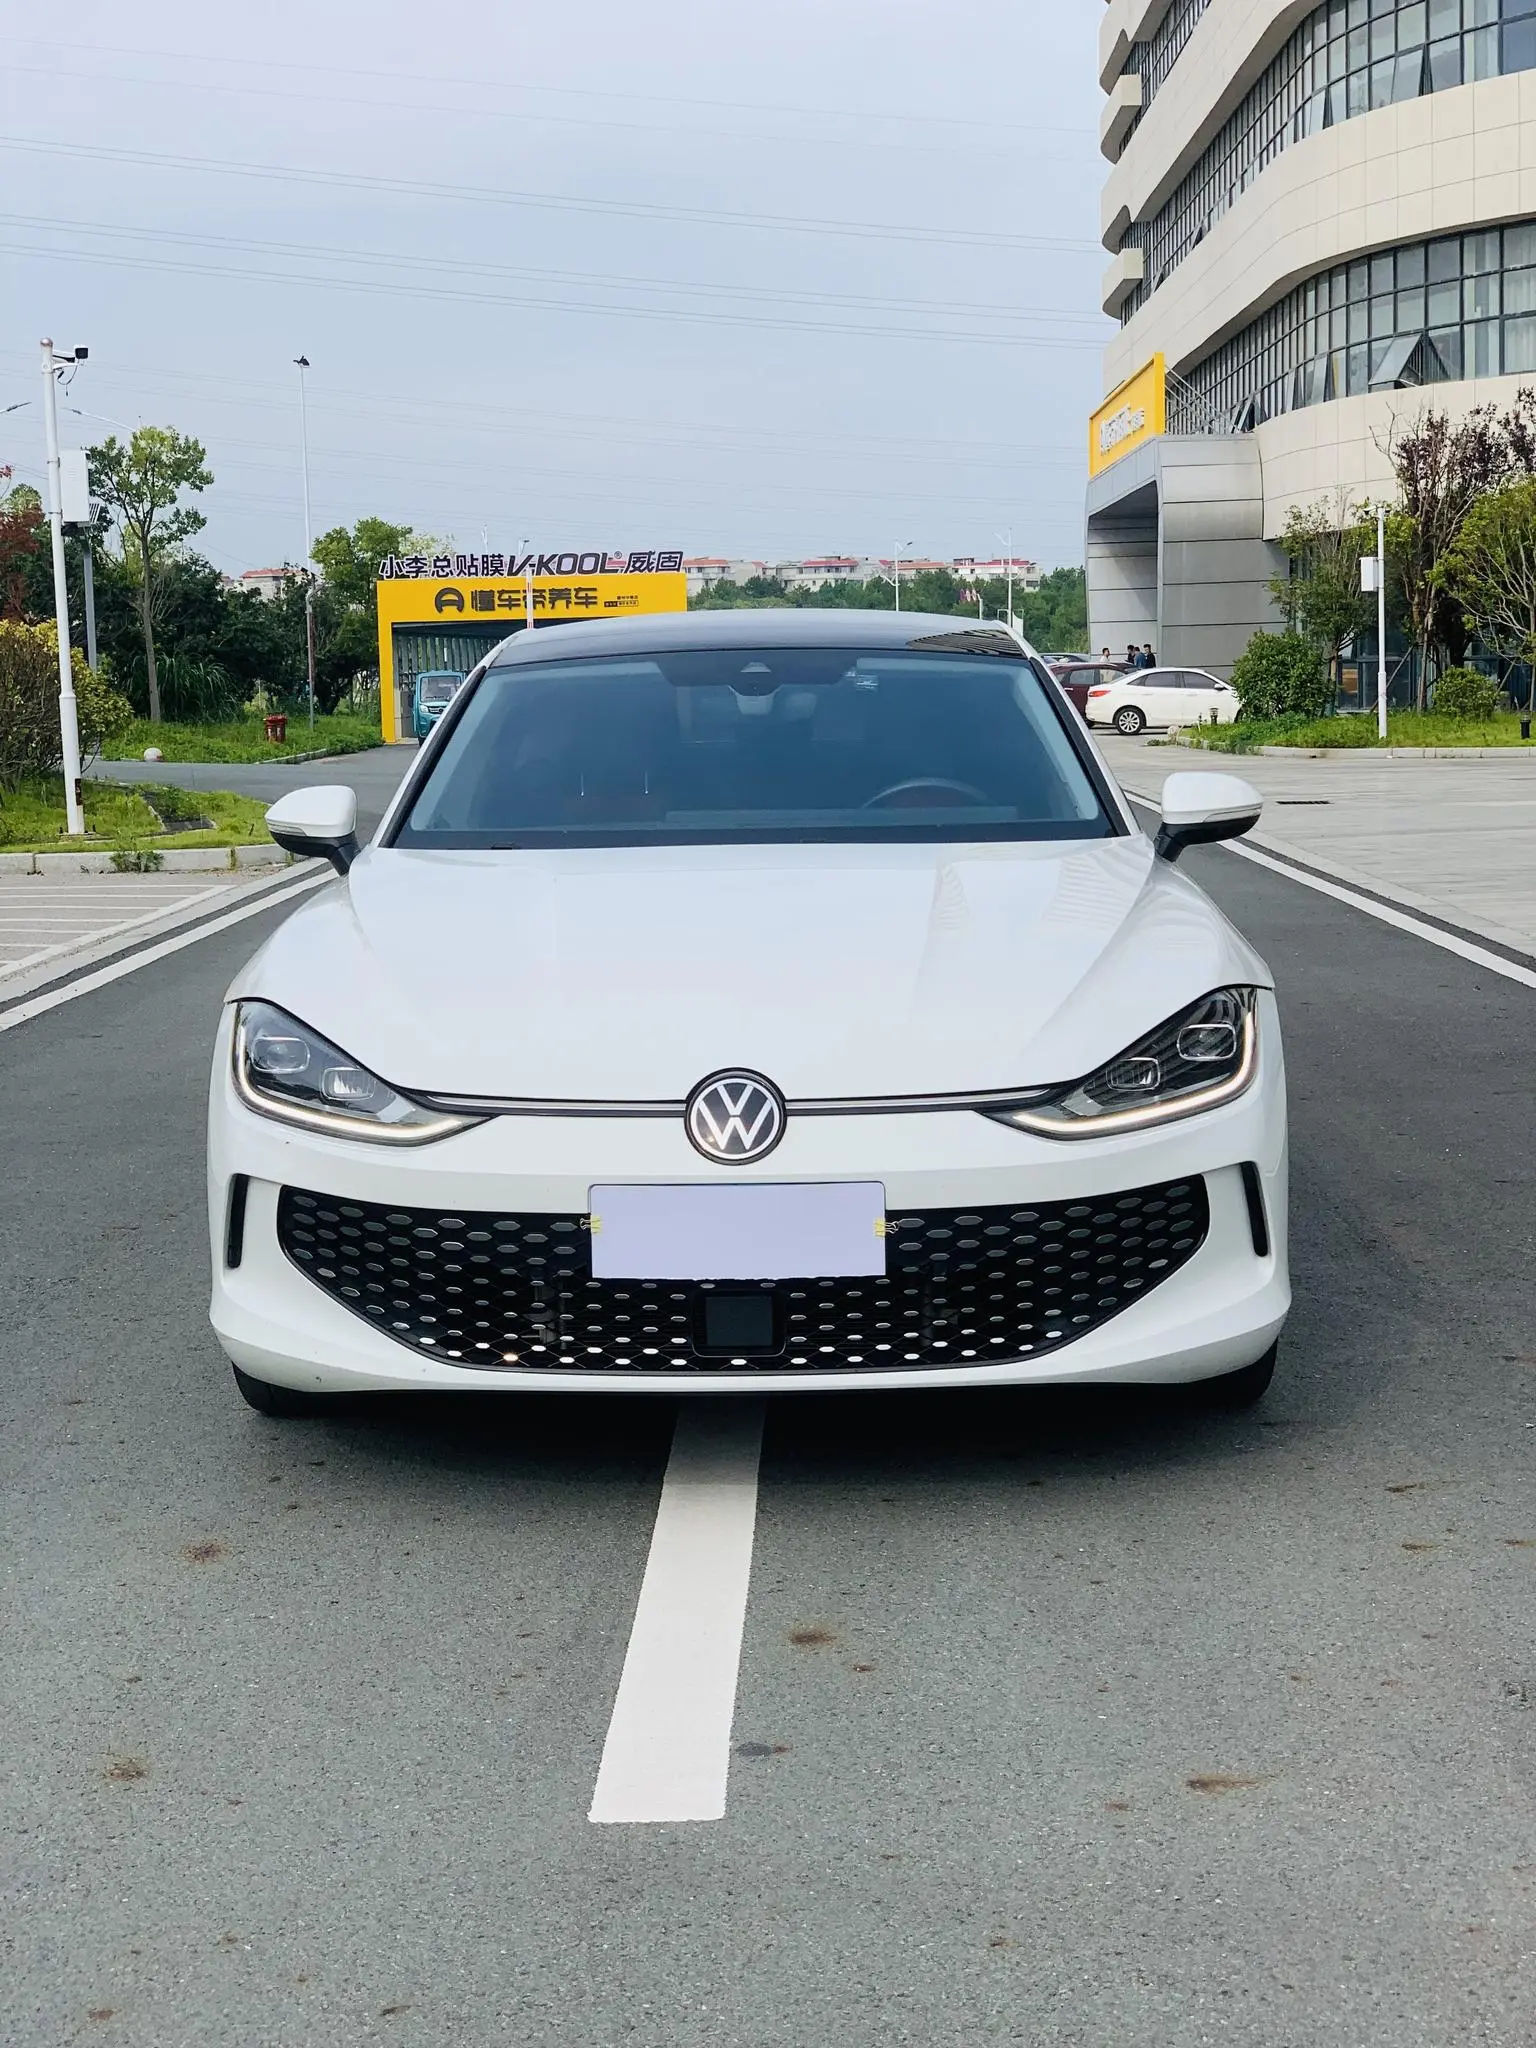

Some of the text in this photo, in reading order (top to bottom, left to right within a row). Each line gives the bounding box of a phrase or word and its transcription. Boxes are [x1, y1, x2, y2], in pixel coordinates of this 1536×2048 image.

[380, 554, 504, 579] 小李总贴膜
[624, 551, 683, 573] 威固
[692, 1079, 779, 1157] VW
